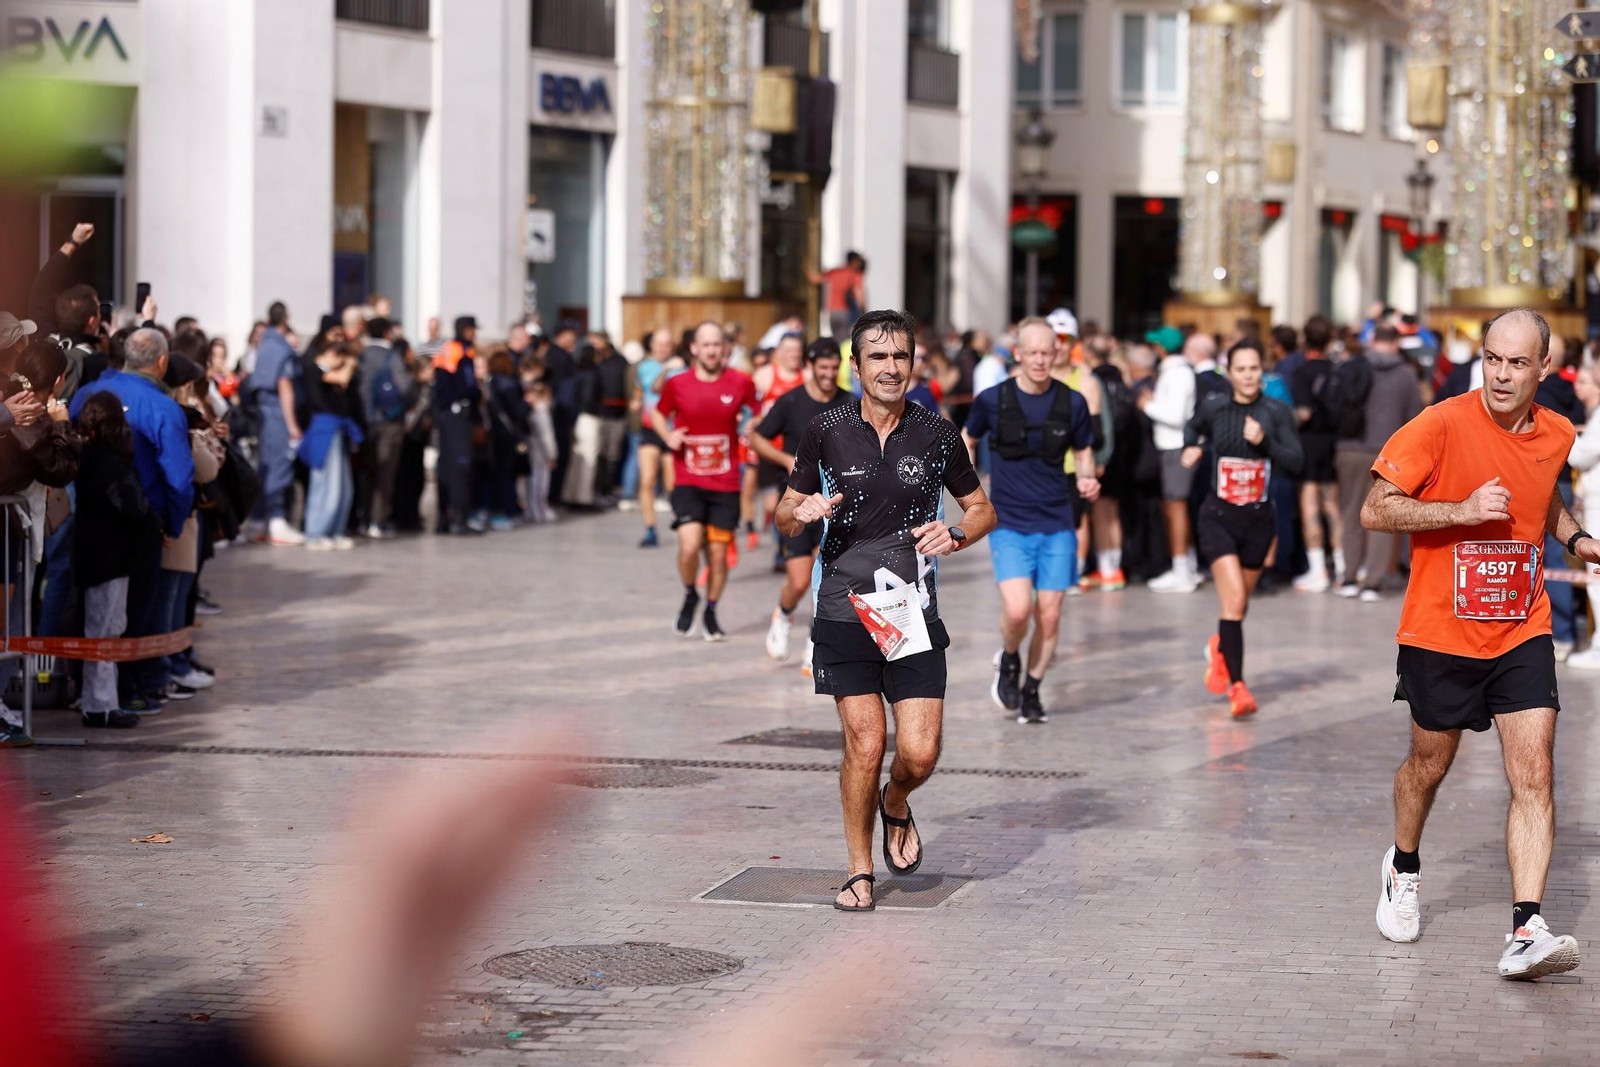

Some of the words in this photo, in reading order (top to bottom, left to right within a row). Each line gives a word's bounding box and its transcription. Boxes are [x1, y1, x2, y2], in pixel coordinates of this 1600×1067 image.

[540, 72, 612, 115] BBVA
[1479, 544, 1527, 554] GENERALI
[1476, 561, 1517, 576] 4597
